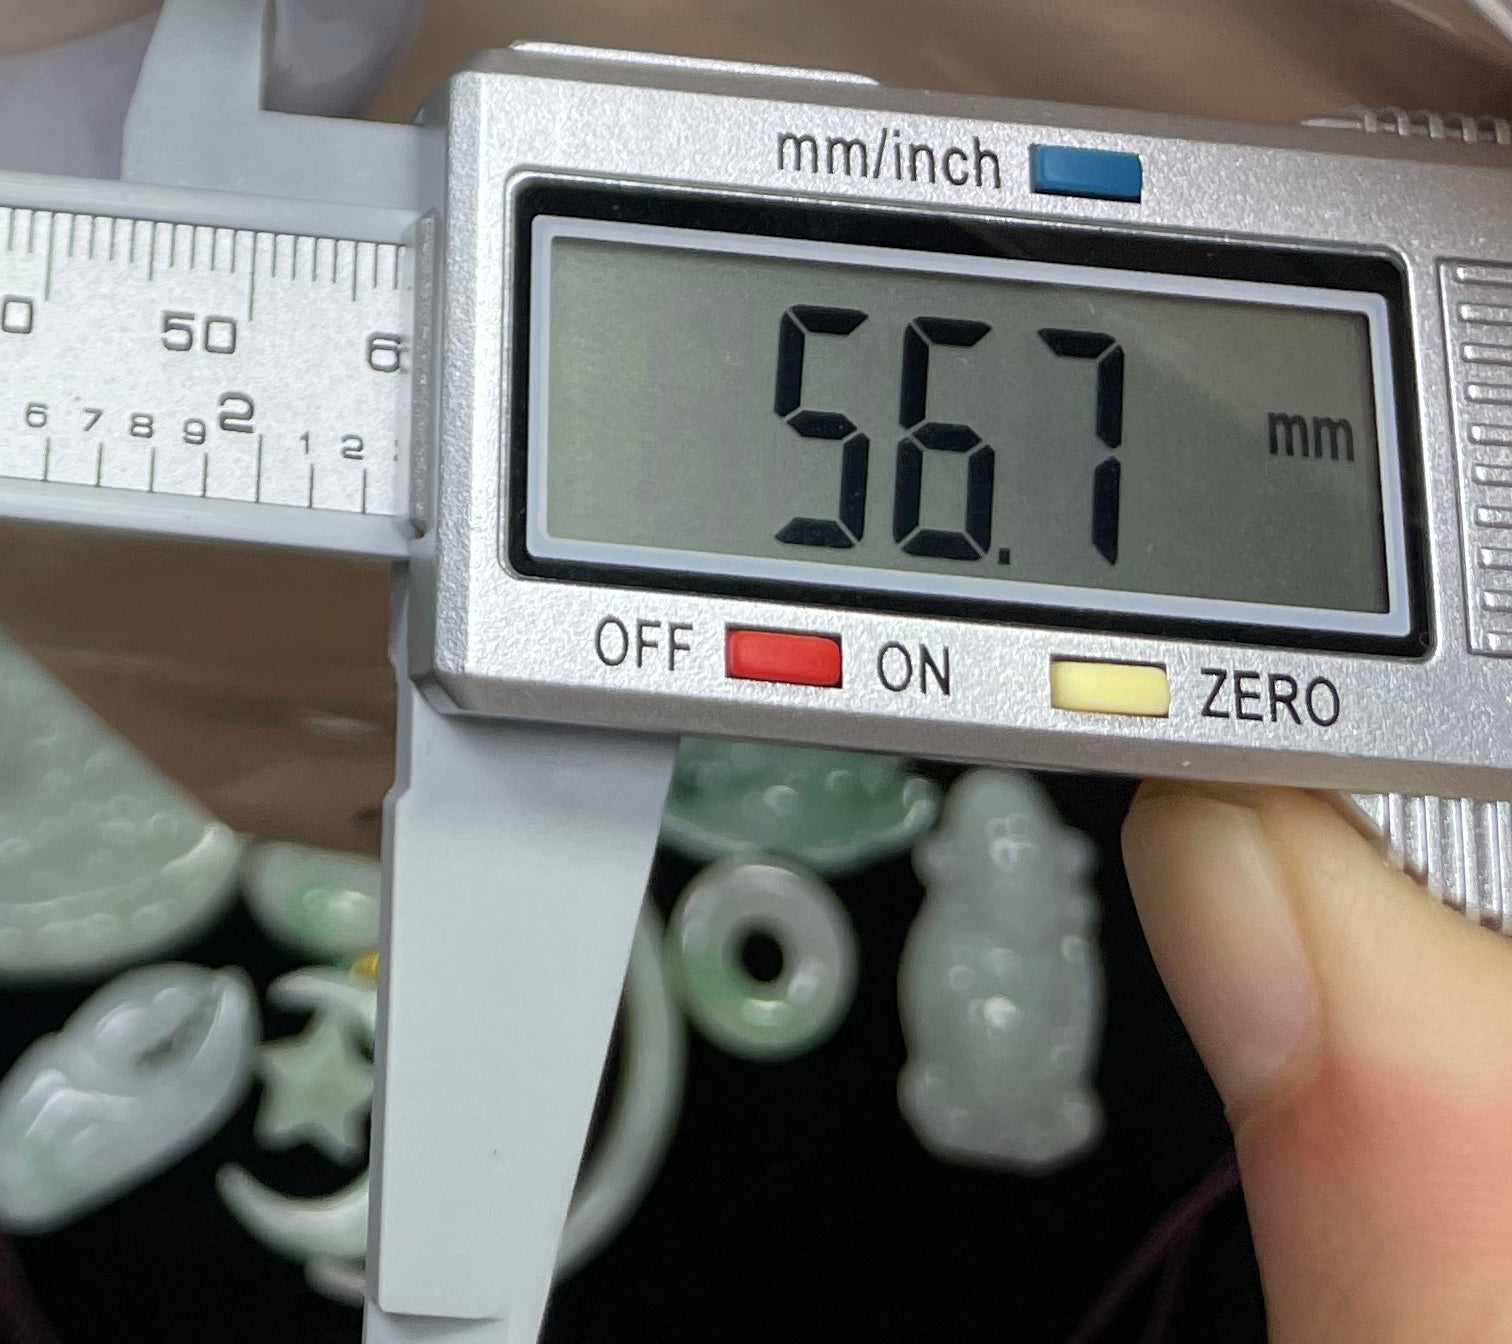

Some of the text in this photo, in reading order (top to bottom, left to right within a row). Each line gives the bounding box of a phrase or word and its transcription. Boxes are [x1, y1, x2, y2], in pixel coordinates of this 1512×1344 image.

[776, 127, 1002, 190] mm/inch
[159, 310, 238, 354] 50
[365, 330, 408, 374] 6
[24, 402, 48, 428] 6
[82, 407, 103, 432] 7
[130, 412, 155, 439] 8
[182, 418, 207, 445] 9
[218, 390, 255, 434] 2
[300, 430, 311, 455] 1
[340, 434, 365, 460] 2
[774, 304, 1355, 565] 56.7 mm
[593, 615, 695, 673] OFF
[876, 640, 950, 697] ON
[1199, 667, 1341, 729] ZERO
